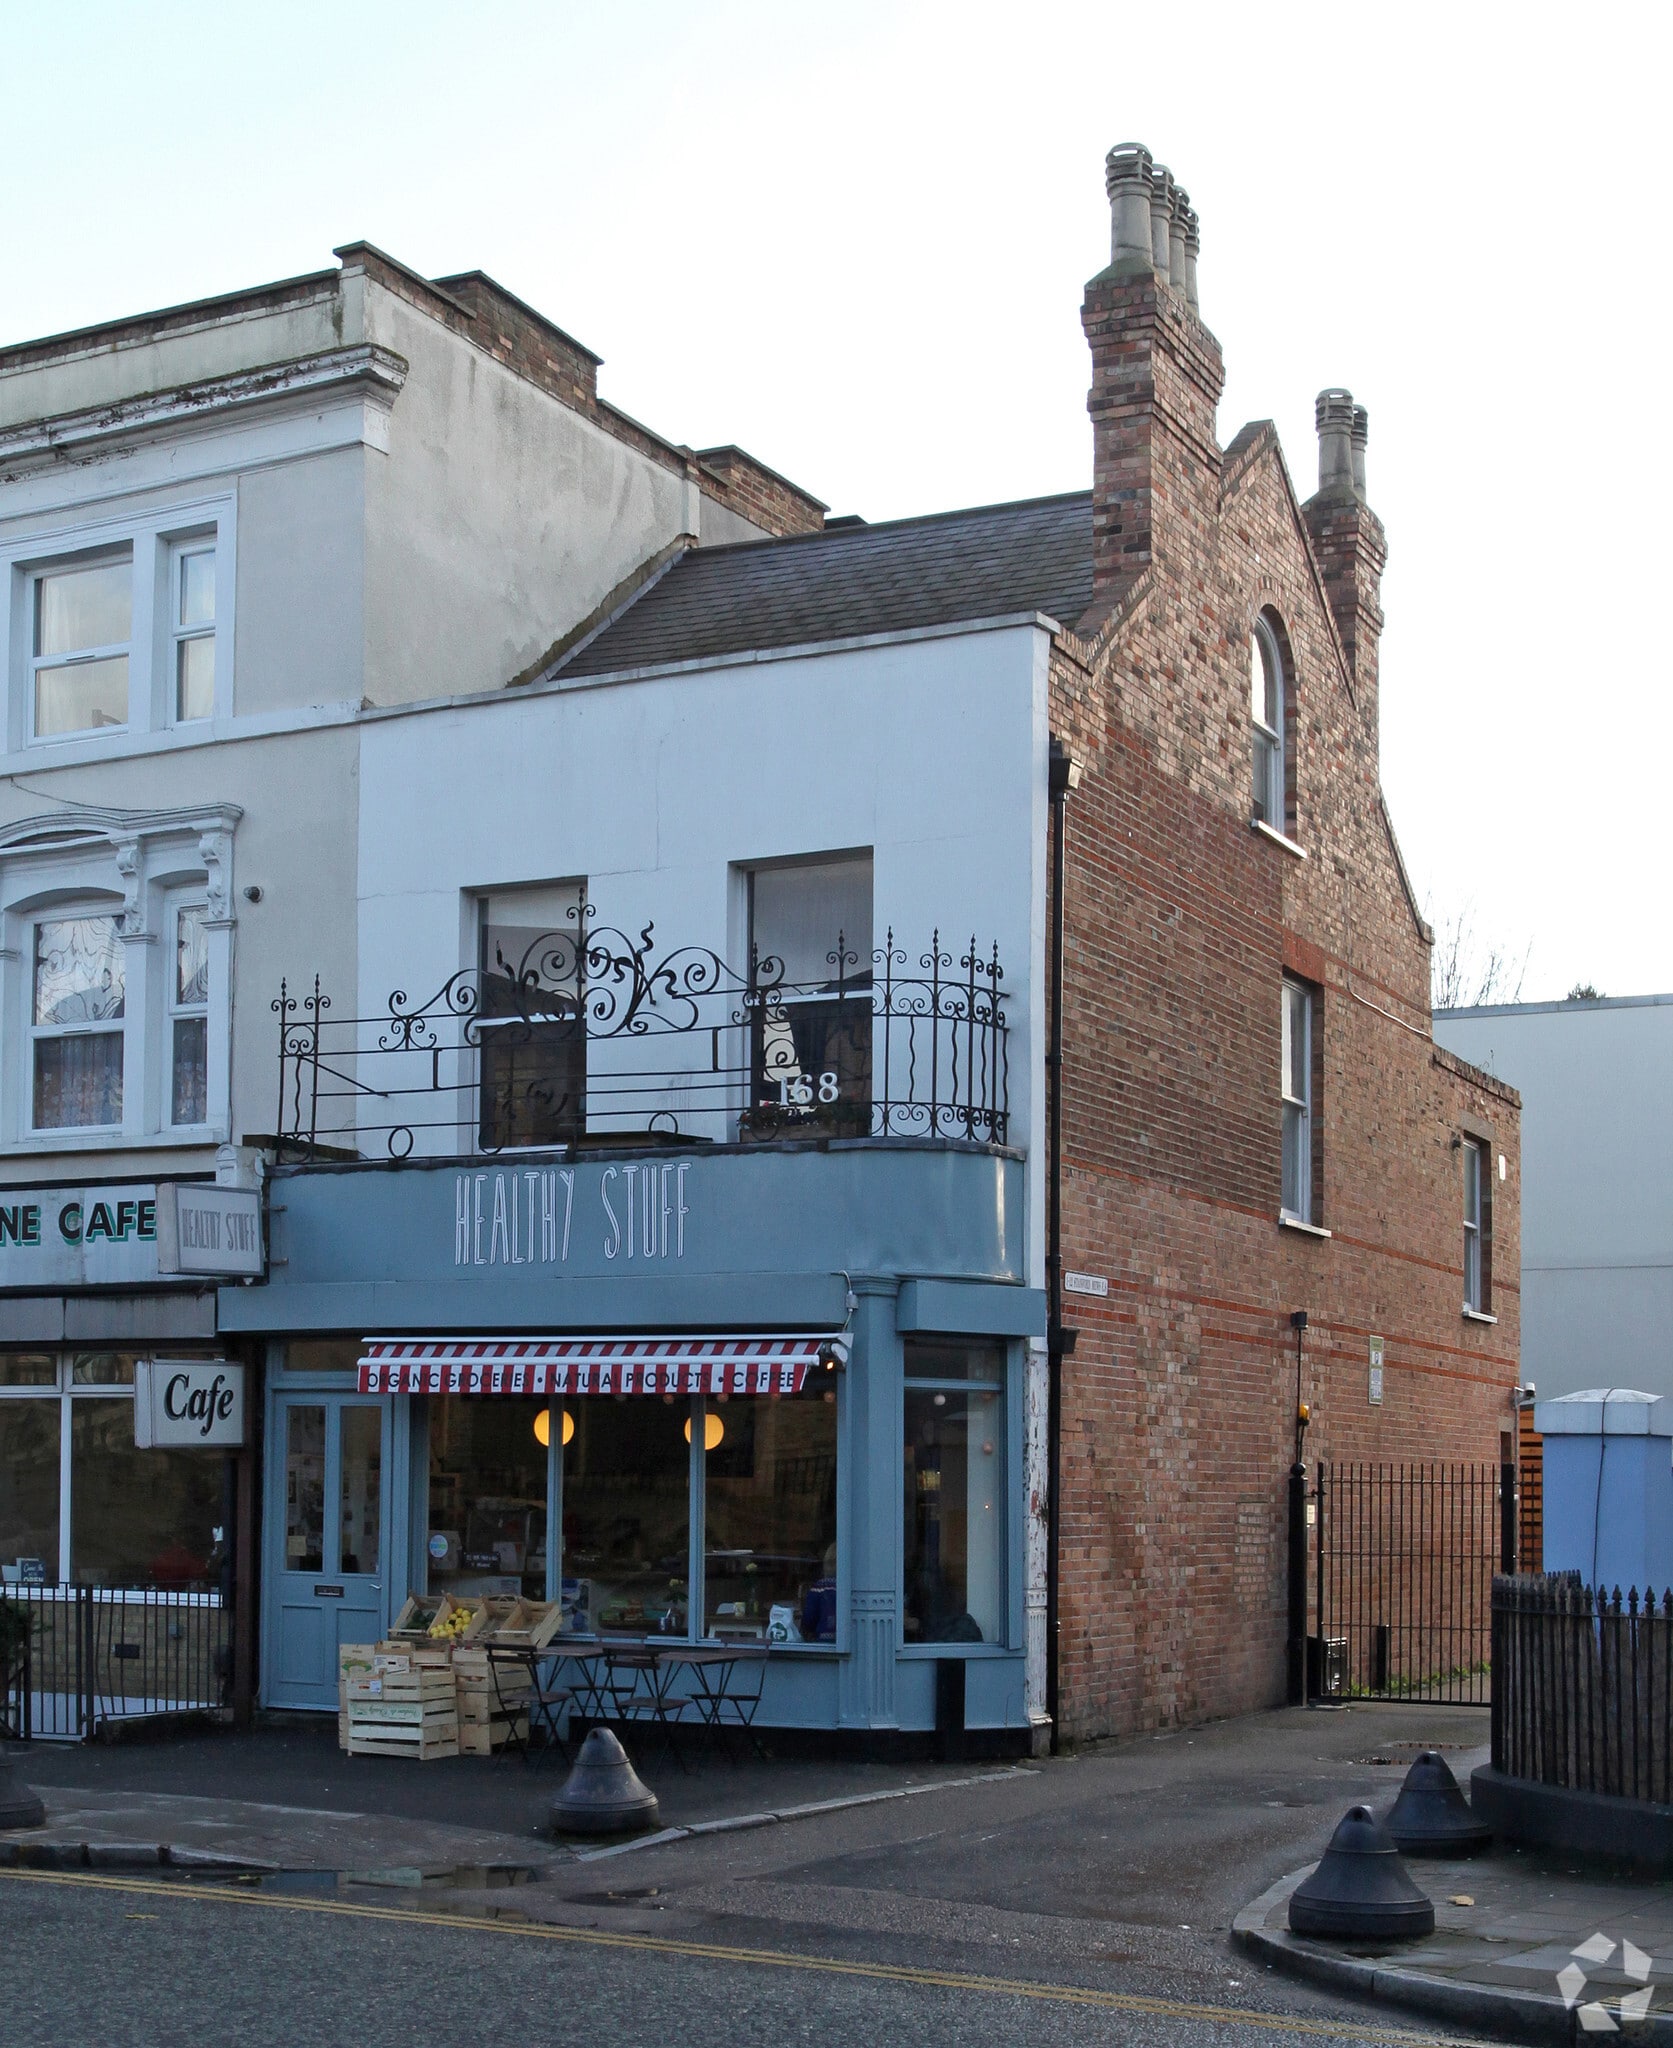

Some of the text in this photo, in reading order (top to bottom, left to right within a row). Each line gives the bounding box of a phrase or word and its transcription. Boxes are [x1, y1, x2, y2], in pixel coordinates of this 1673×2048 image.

[779, 1072, 839, 1106] 168
[58, 1200, 157, 1246] CAFE
[182, 1208, 255, 1252] HEALTHY STUFF
[455, 1162, 692, 1266] HEALTHY STUFF
[367, 1371, 795, 1388] ORGANIC GROCERIES NATURAL PRODUCTS COFFEE
[164, 1374, 234, 1436] Cafe
